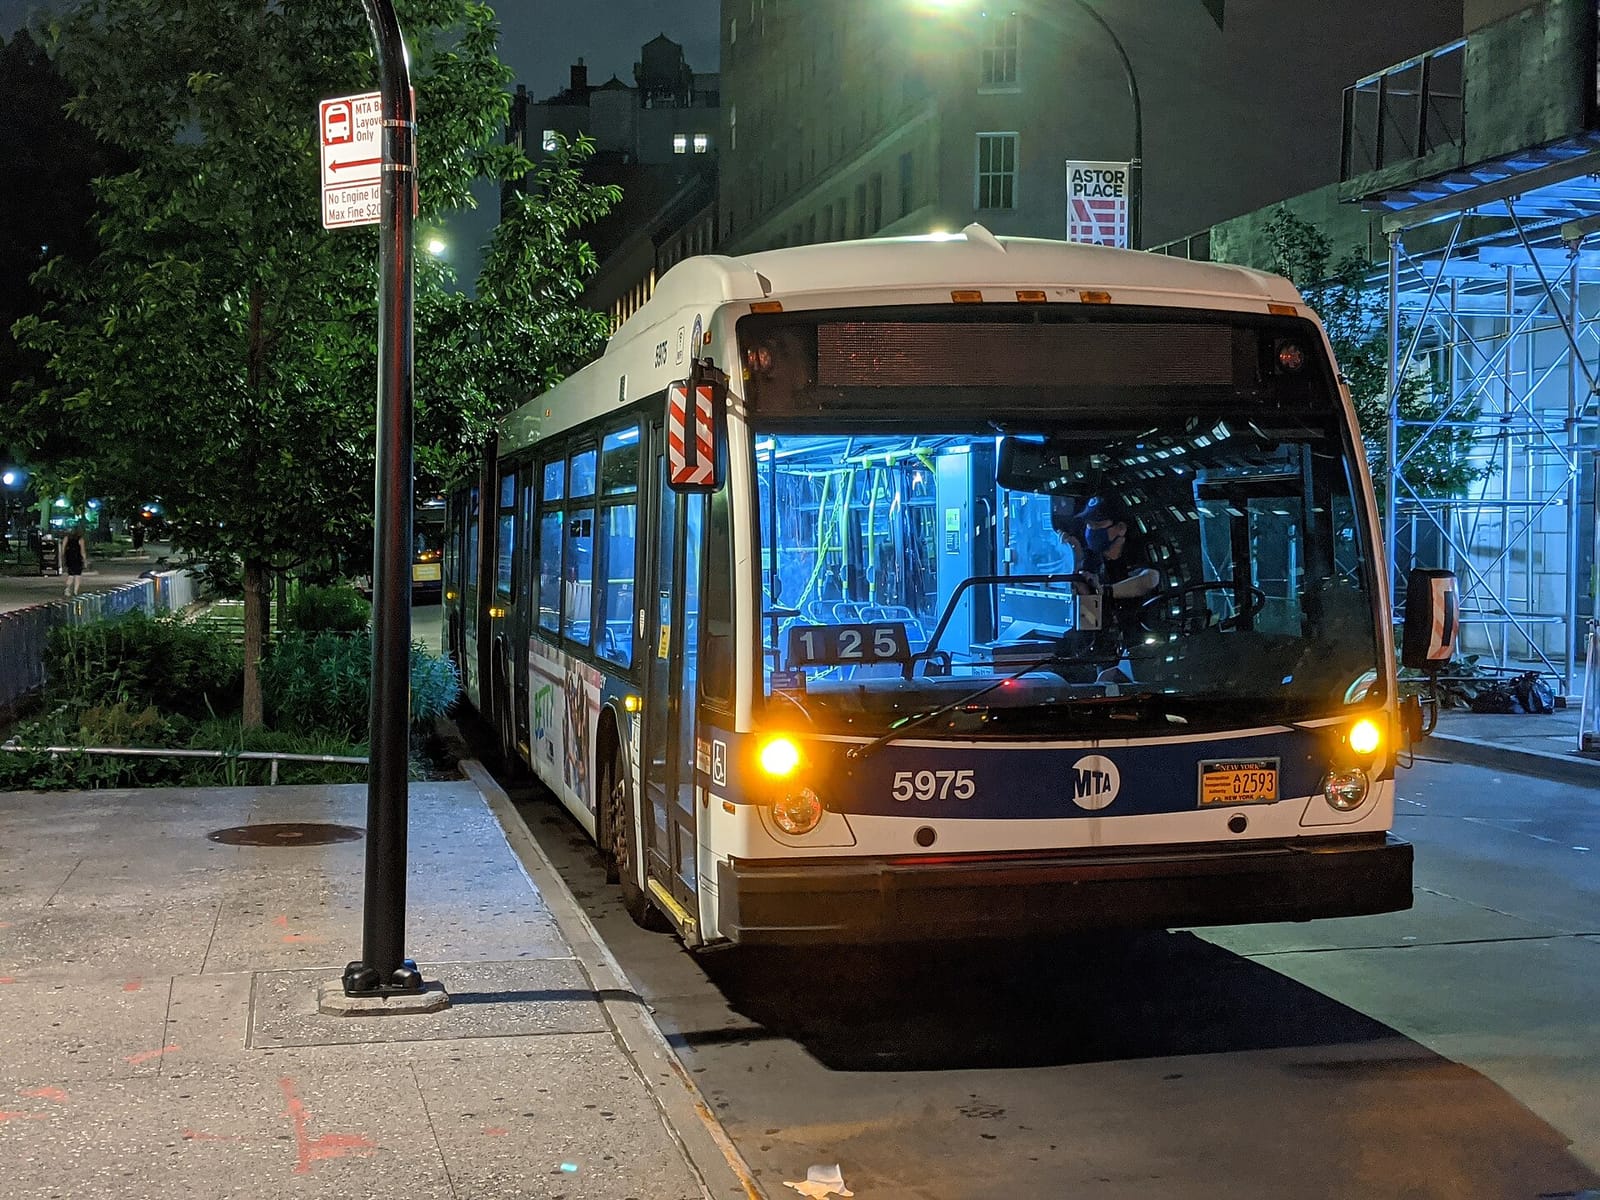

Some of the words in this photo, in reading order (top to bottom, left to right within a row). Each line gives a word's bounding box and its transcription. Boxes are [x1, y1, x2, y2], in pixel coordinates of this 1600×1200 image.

[355, 102, 372, 114] MTA
[356, 116, 383, 129] Layove
[356, 131, 374, 142] Only
[1072, 169, 1125, 184] ASTOR
[328, 192, 340, 204] No
[342, 189, 369, 204] Engine
[1073, 183, 1122, 197] PLACE
[328, 208, 345, 220] Max
[348, 206, 364, 218] Fine
[892, 769, 975, 801] 5975
[1072, 768, 1112, 798] MTA
